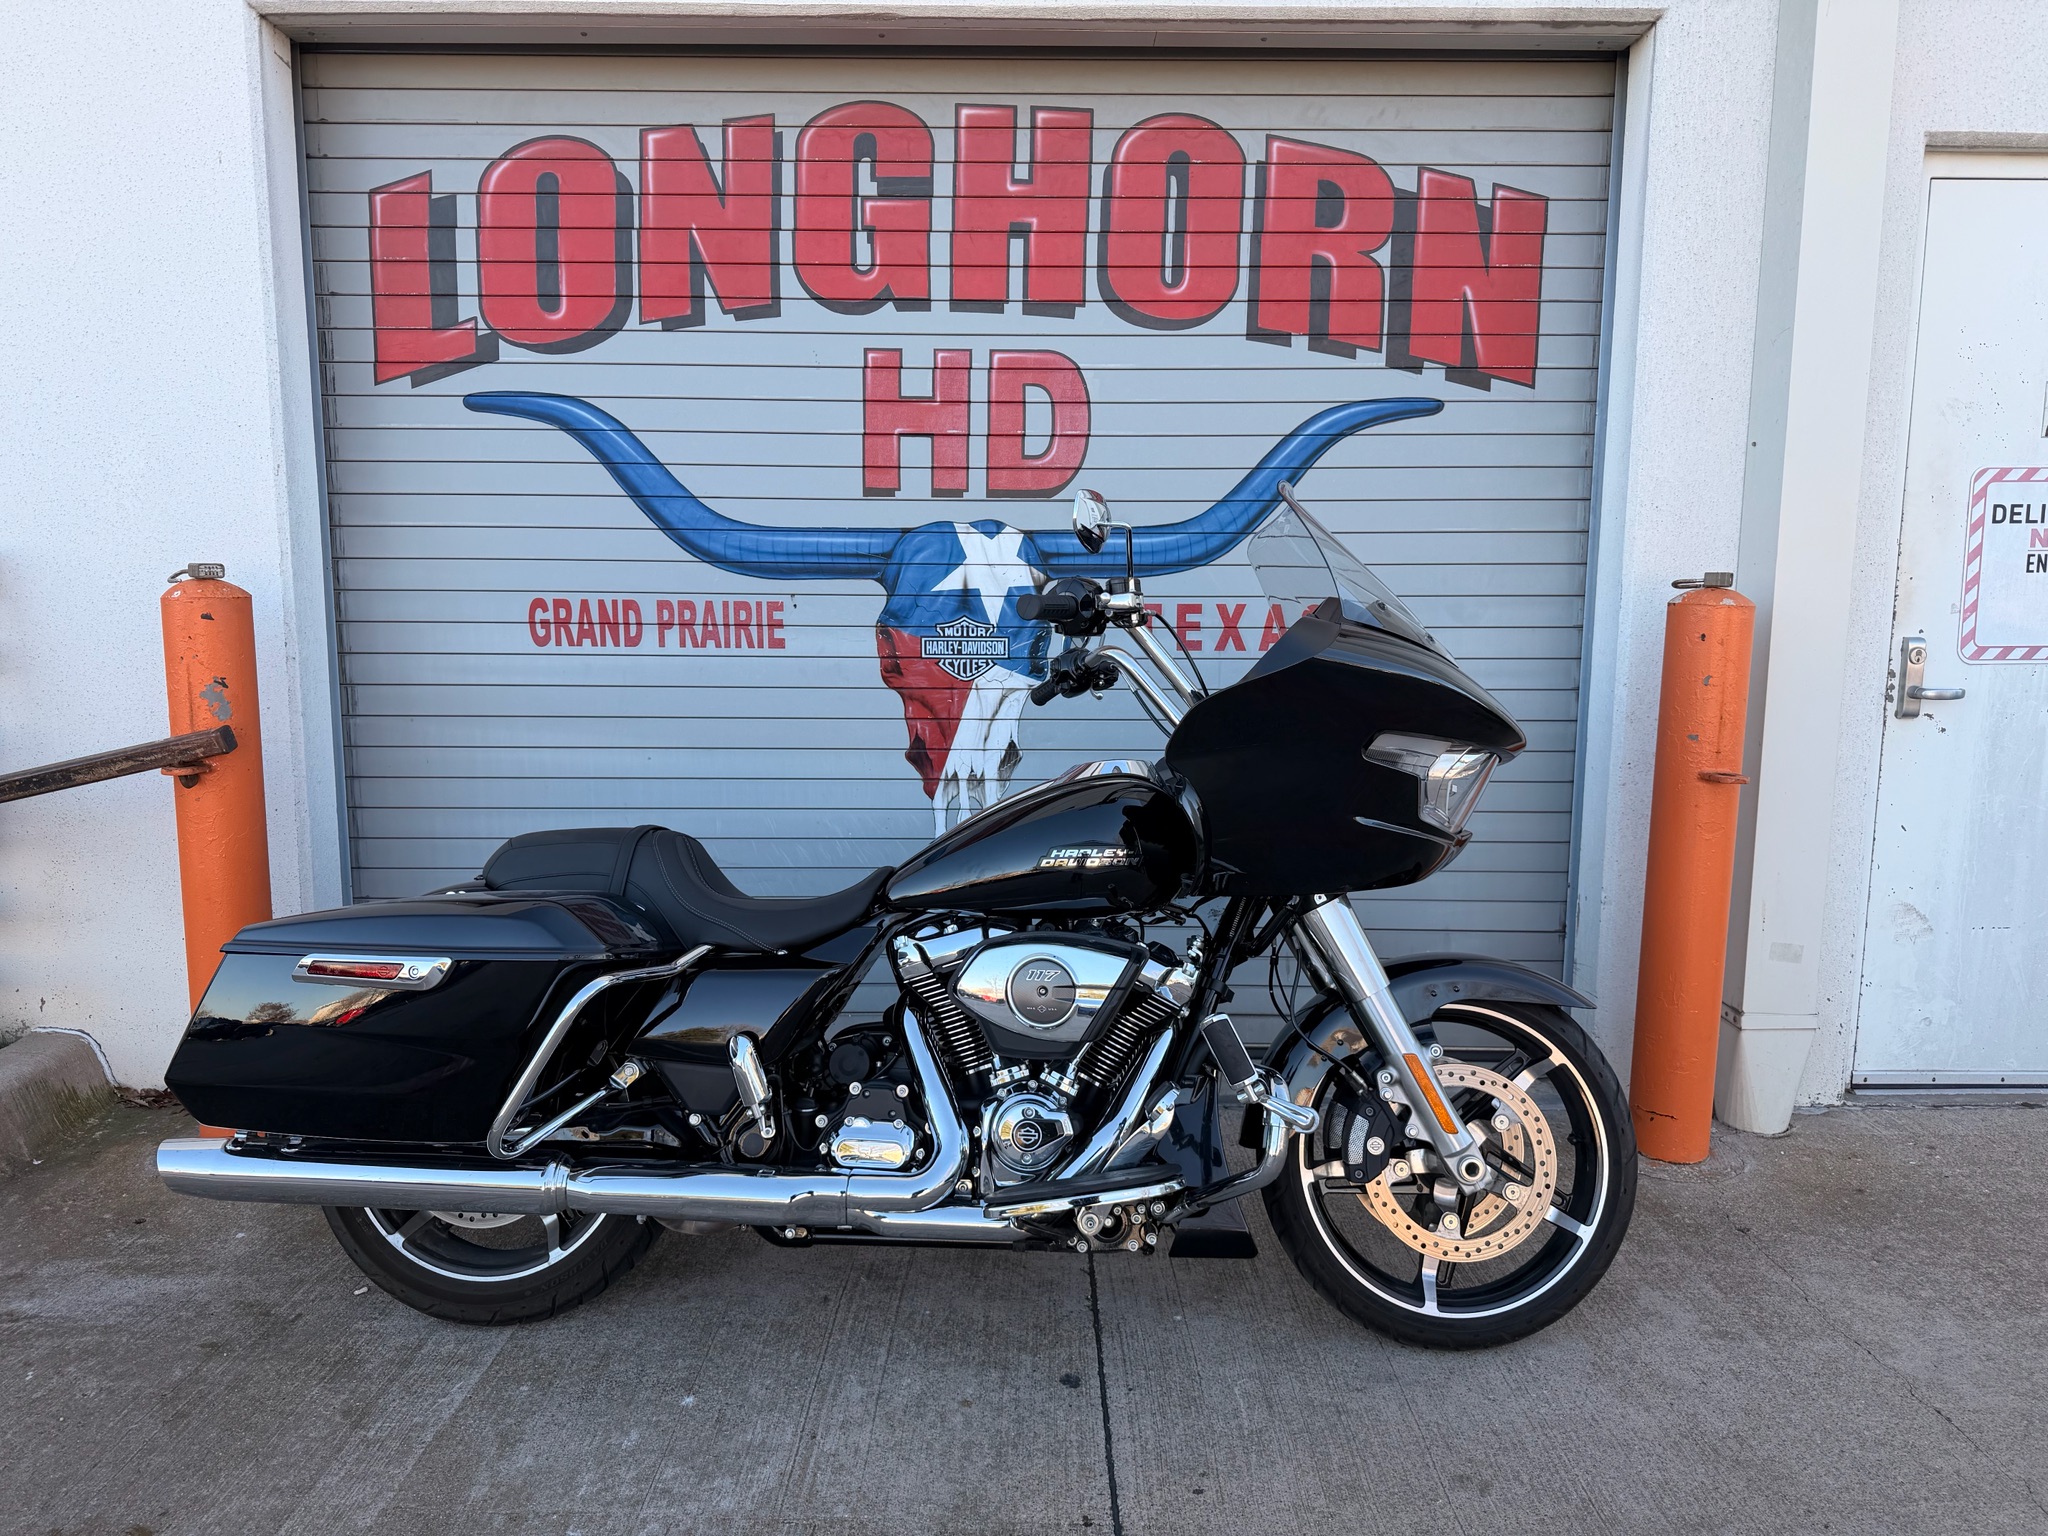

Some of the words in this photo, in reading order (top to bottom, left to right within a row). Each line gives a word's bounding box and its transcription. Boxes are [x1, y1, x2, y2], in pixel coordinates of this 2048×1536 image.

[368, 101, 1549, 388] LONGHORN
[862, 348, 1092, 498] HD
[528, 597, 643, 648] GRAND
[656, 599, 786, 650] PRAIRIE
[945, 621, 986, 637] MOTOR
[1143, 603, 1321, 652] TEXA
[926, 640, 1005, 655] HARLEY-DAVIDSON
[945, 659, 987, 678] CYCLES
[1026, 969, 1062, 982] 117
